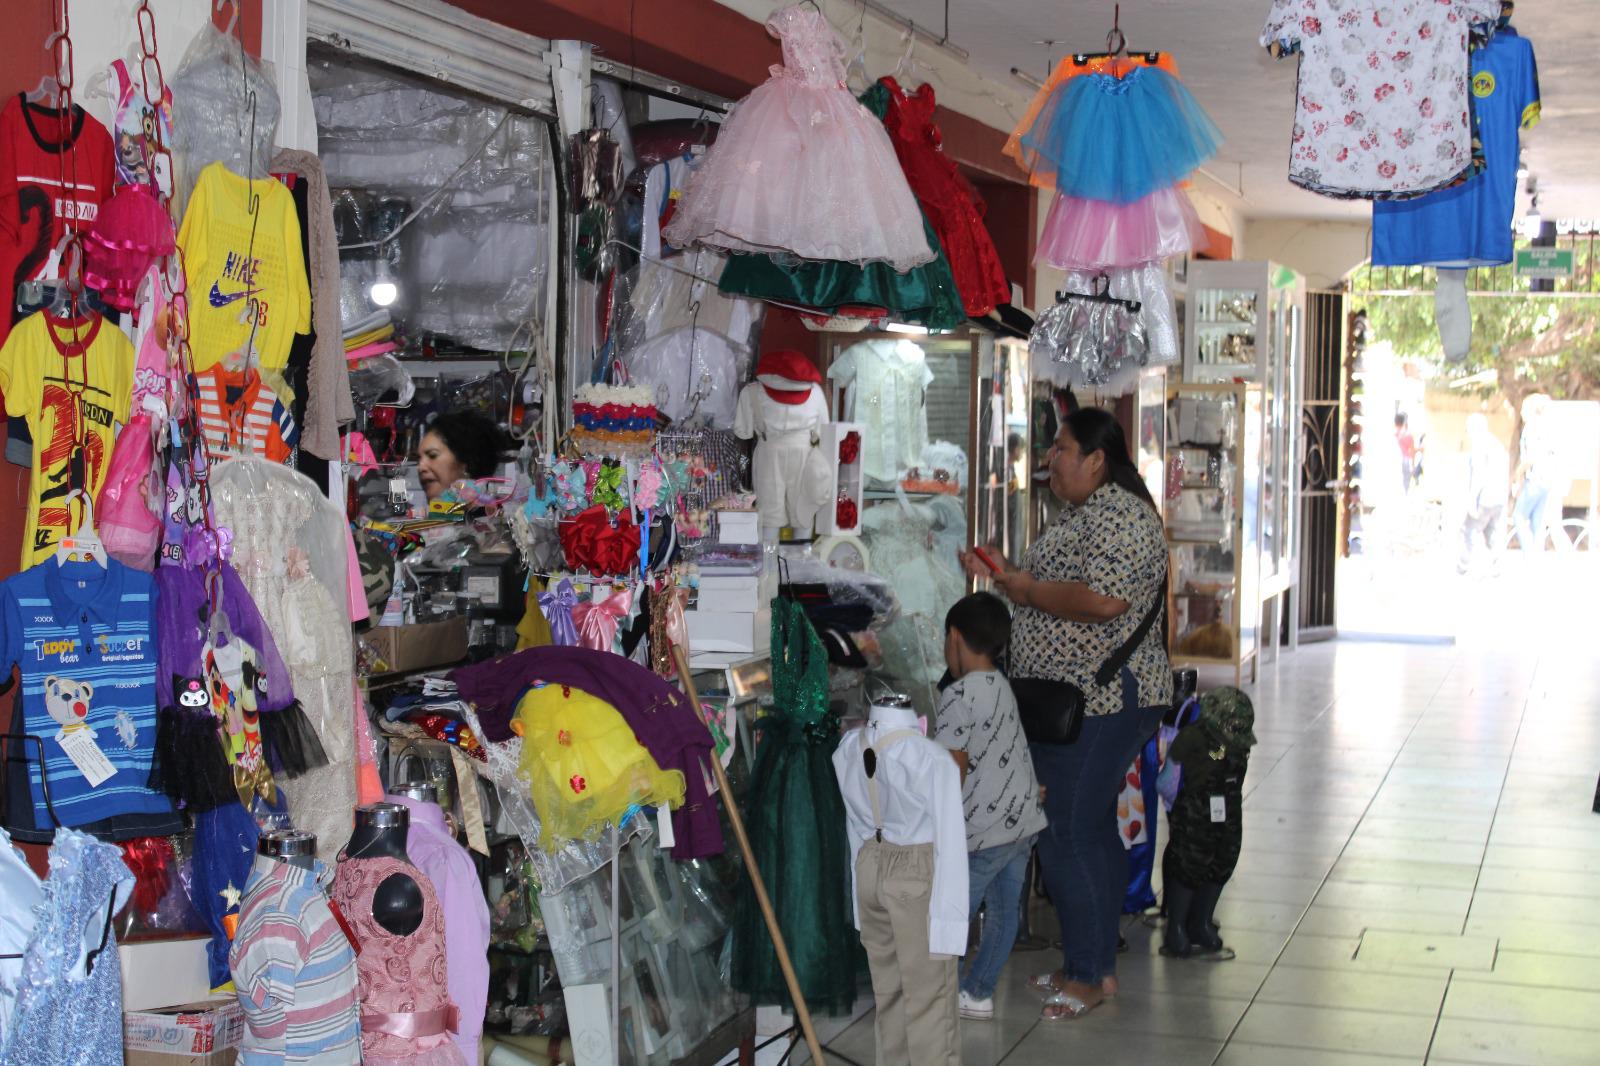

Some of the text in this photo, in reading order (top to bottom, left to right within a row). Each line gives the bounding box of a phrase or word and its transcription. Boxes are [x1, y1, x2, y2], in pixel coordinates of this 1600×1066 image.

[56, 200, 96, 219] JRDAN
[223, 251, 263, 286] NIKE
[33, 639, 76, 661] TEDDY
[99, 634, 144, 654] Soccer
[60, 652, 80, 663] bear
